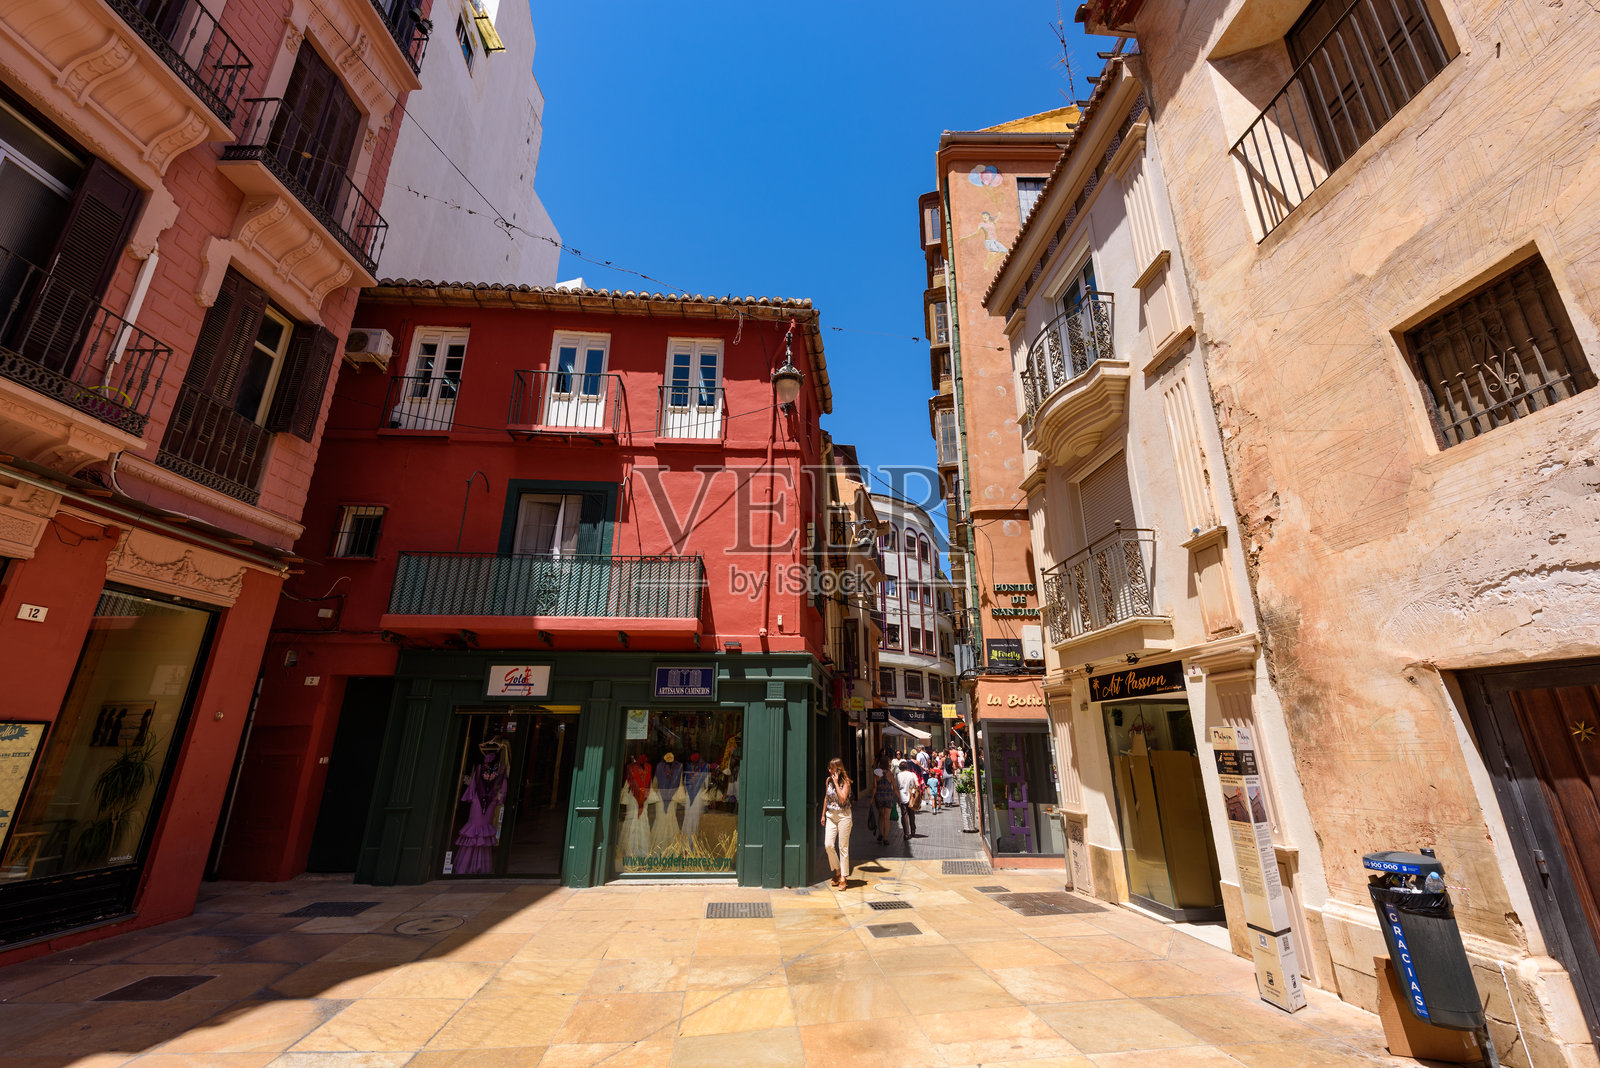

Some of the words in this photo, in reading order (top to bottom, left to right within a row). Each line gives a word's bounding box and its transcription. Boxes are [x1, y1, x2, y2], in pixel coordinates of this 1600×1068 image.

[994, 584, 1035, 592] POSTIG
[1011, 595, 1026, 604] DE
[28, 607, 40, 618] 12
[992, 608, 1014, 617] SAN
[1017, 608, 1041, 617] JUA
[1102, 673, 1123, 698] Art
[1125, 671, 1167, 695] Passion
[1389, 912, 1424, 1006] GRACIAS
